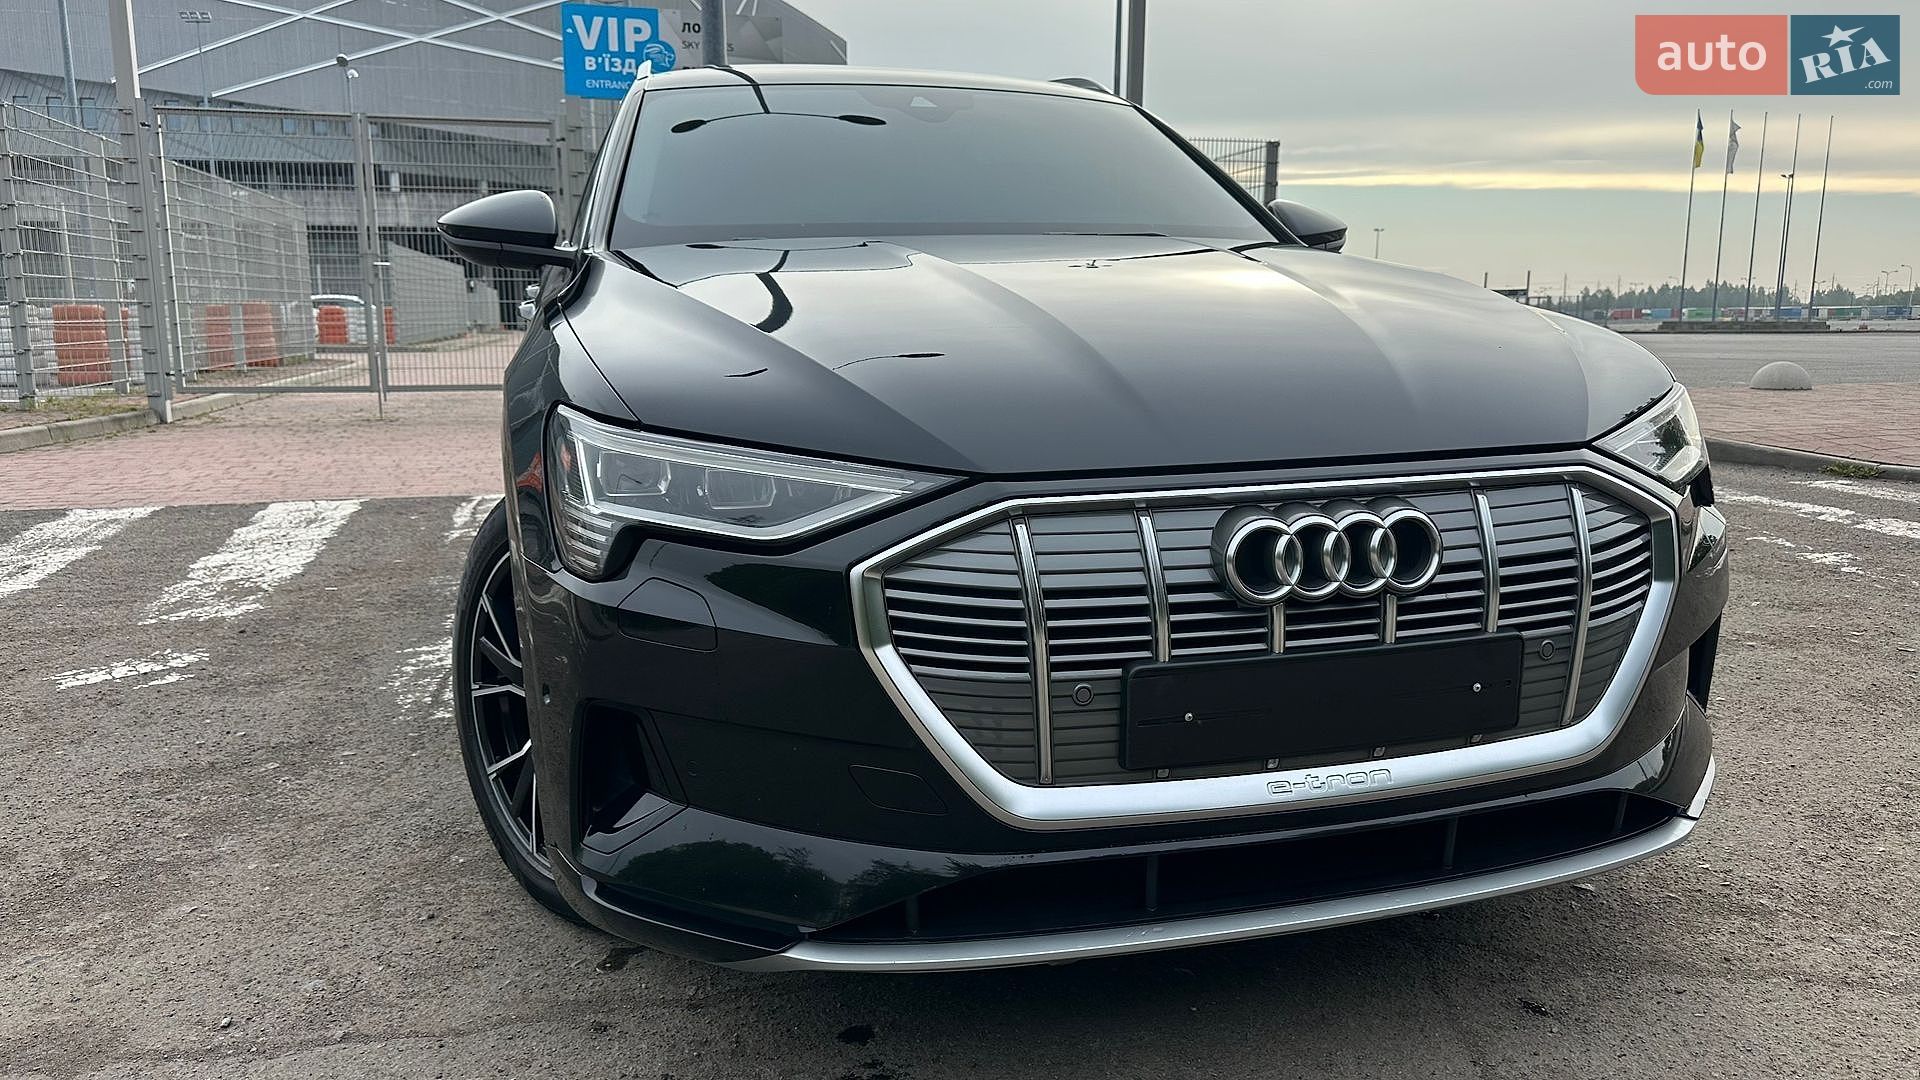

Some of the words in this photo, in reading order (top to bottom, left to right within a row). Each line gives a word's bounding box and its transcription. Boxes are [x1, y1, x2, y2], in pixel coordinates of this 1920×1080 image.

[572, 15, 651, 52] VIP
[682, 40, 700, 50] SKY
[585, 79, 631, 90] ENTRANC
[1266, 768, 1394, 797] e-tron
